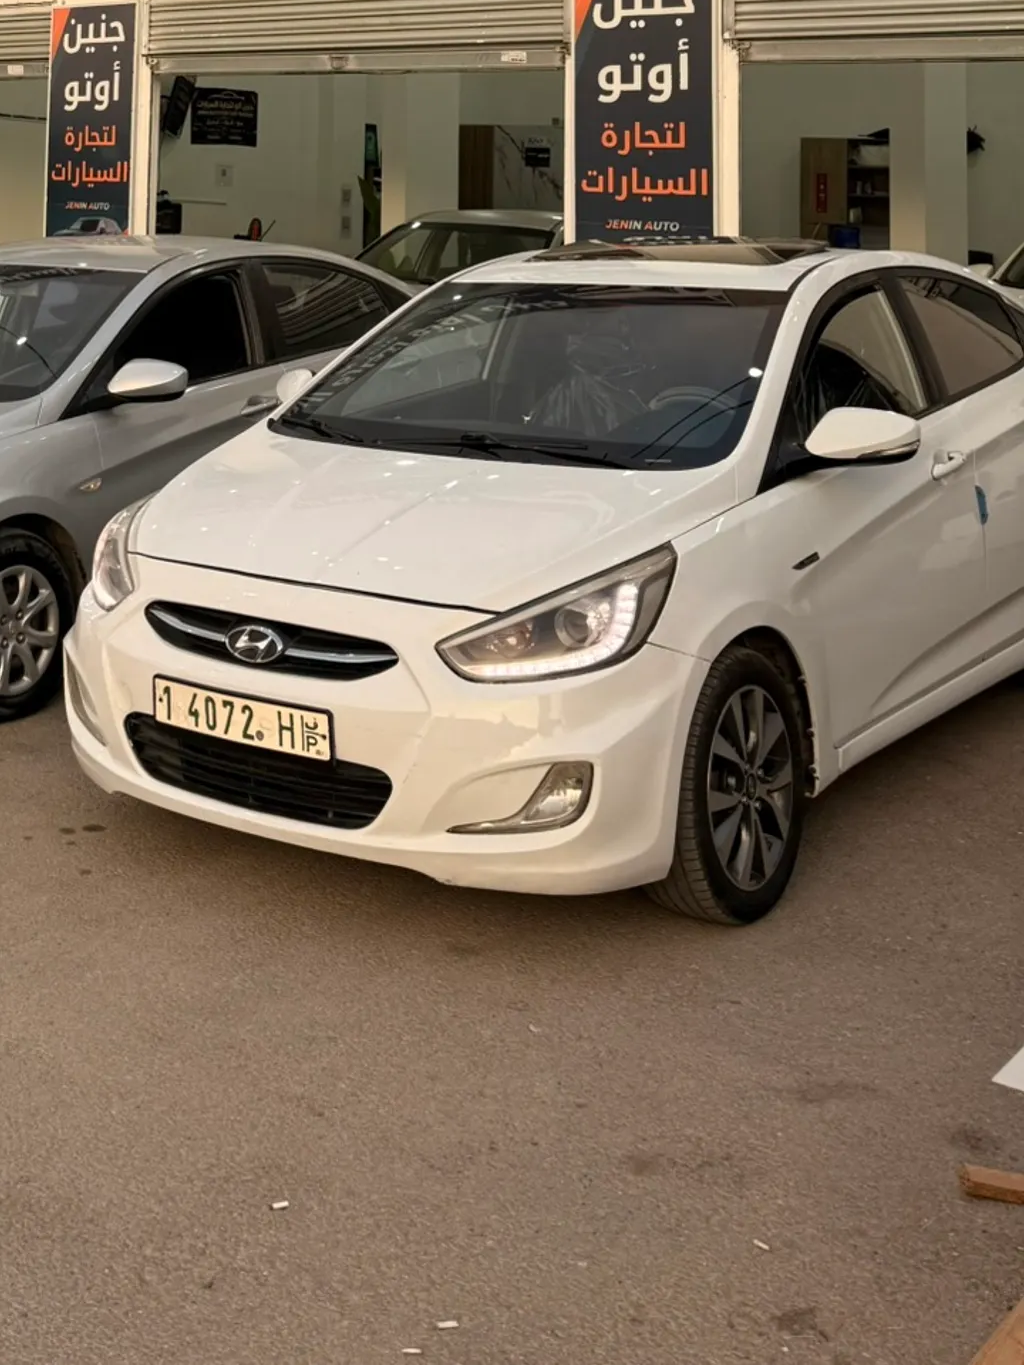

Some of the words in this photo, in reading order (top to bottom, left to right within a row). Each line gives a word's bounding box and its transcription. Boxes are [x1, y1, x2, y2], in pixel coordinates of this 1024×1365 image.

[62, 14, 126, 54] جنين
[64, 61, 121, 112] أوتو
[597, 38, 690, 104] أوتو
[64, 125, 117, 152] لتجارة
[601, 121, 686, 156] لتجارة
[51, 161, 128, 188] السيارات
[581, 166, 708, 202] السيارات
[65, 201, 88, 210] JENIN
[88, 201, 110, 211] AUTO
[605, 219, 642, 231] JENIN
[644, 220, 680, 232] AUTO
[162, 685, 173, 721] 1
[187, 692, 255, 742] 4072
[277, 710, 296, 750] H
[306, 735, 318, 752] P
